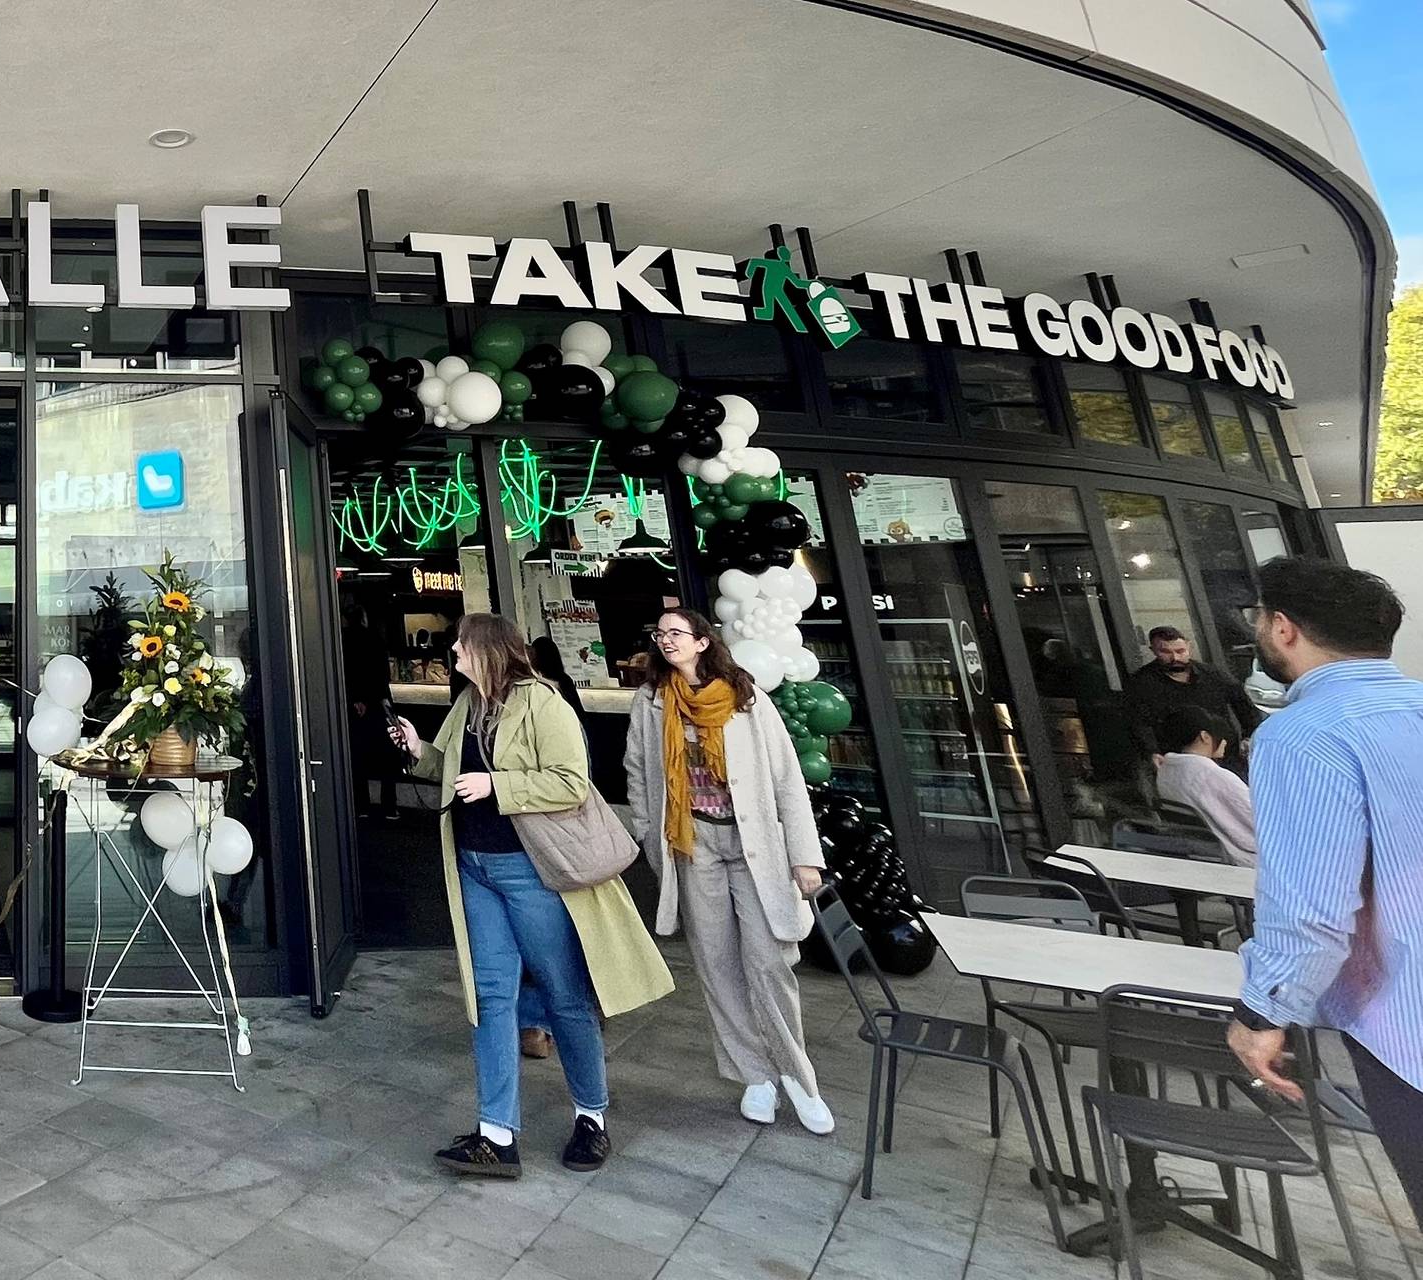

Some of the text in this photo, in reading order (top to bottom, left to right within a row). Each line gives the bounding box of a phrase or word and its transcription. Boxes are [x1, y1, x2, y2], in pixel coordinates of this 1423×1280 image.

[408, 232, 1295, 400] TAKE THE GOOD FOOD
[554, 552, 578, 561] ORDER
